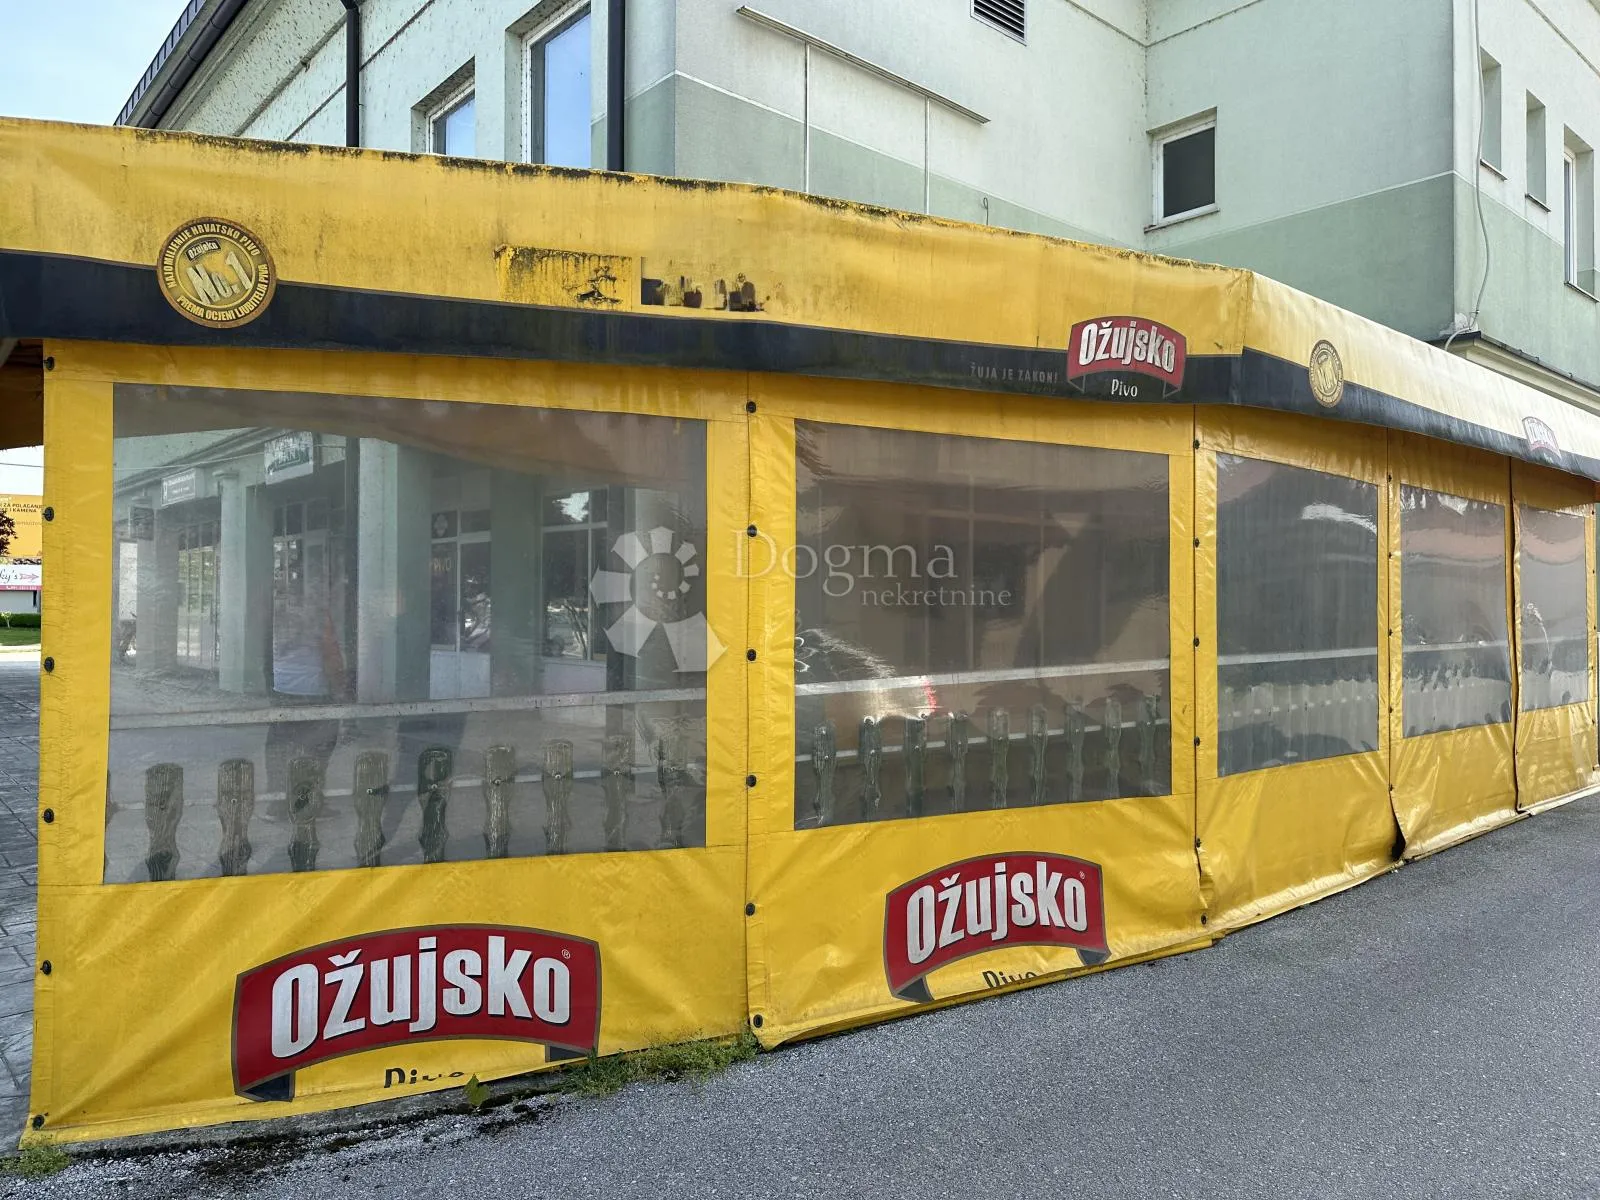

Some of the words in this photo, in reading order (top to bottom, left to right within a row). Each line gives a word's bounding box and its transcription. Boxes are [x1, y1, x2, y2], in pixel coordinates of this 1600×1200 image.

[163, 229, 192, 288] NAJOMILJENIJE
[192, 223, 240, 239] HRVATSKO
[240, 235, 261, 257] PIVO
[186, 250, 254, 305] No.1
[177, 295, 205, 317] PREMA
[205, 310, 236, 321] OCJENI
[234, 282, 268, 320] LJUBITELJA
[258, 263, 269, 283] PIVA
[970, 361, 998, 380] ŽUJA
[1002, 368, 1013, 381] JE
[1078, 319, 1176, 374] Ožujsko
[1111, 378, 1138, 398] Pivo
[906, 861, 1089, 965] Ožujsko
[270, 935, 572, 1059] Ožujsko
